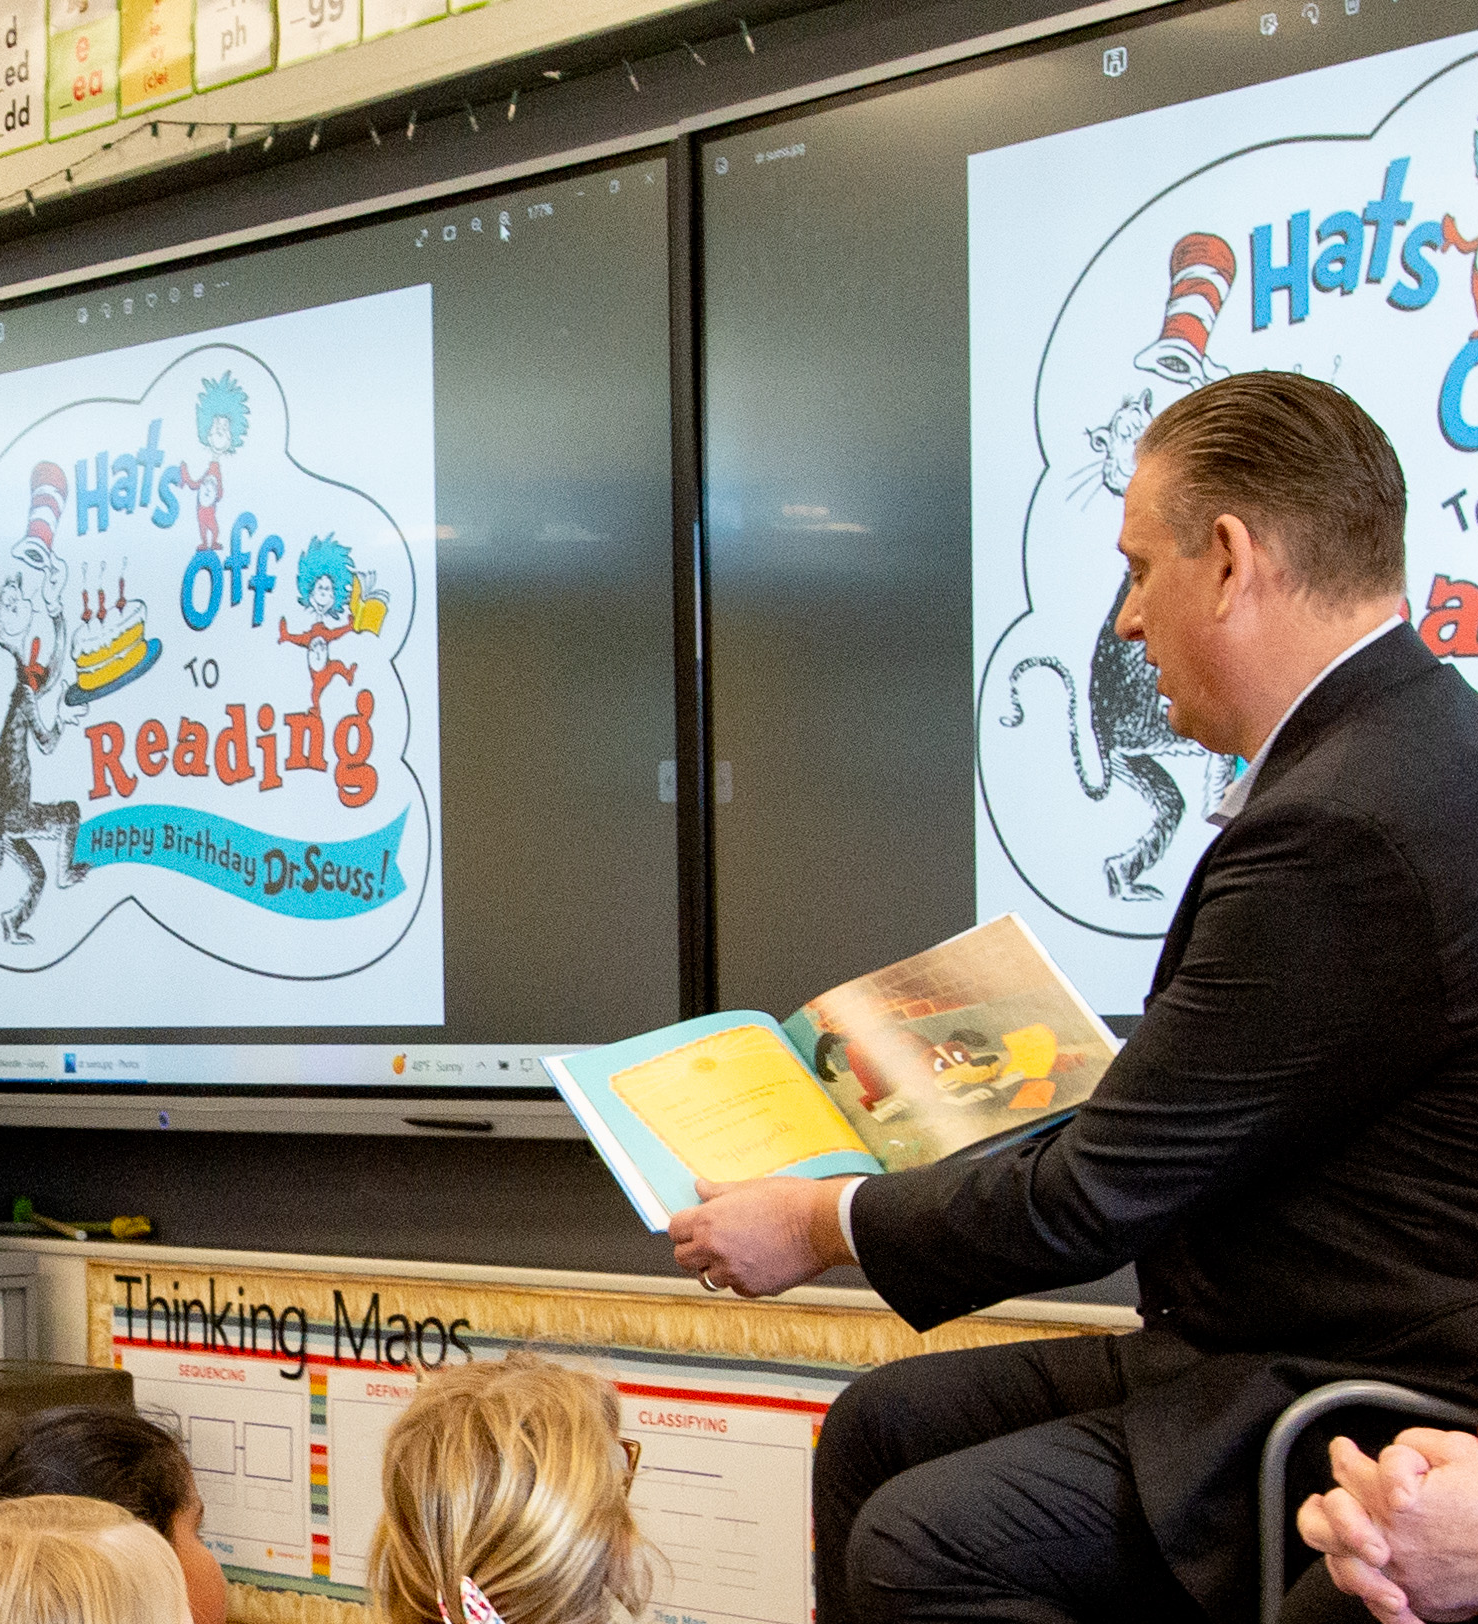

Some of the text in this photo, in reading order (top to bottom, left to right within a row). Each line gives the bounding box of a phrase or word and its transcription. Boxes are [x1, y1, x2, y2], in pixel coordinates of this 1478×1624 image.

[6, 15, 18, 48] d
[75, 36, 90, 62] e
[221, 16, 247, 60] ph
[1248, 156, 1444, 332] Hats
[74, 419, 184, 536] Hats
[180, 511, 286, 632] Off
[184, 656, 220, 689] TO
[85, 689, 378, 808] Reading
[91, 823, 155, 857] Happy
[162, 823, 257, 888] Birthday
[114, 1273, 474, 1381] Thinking Maps
[178, 1363, 247, 1383] SEQUENCING
[638, 1410, 729, 1434] CLASSIFYING
